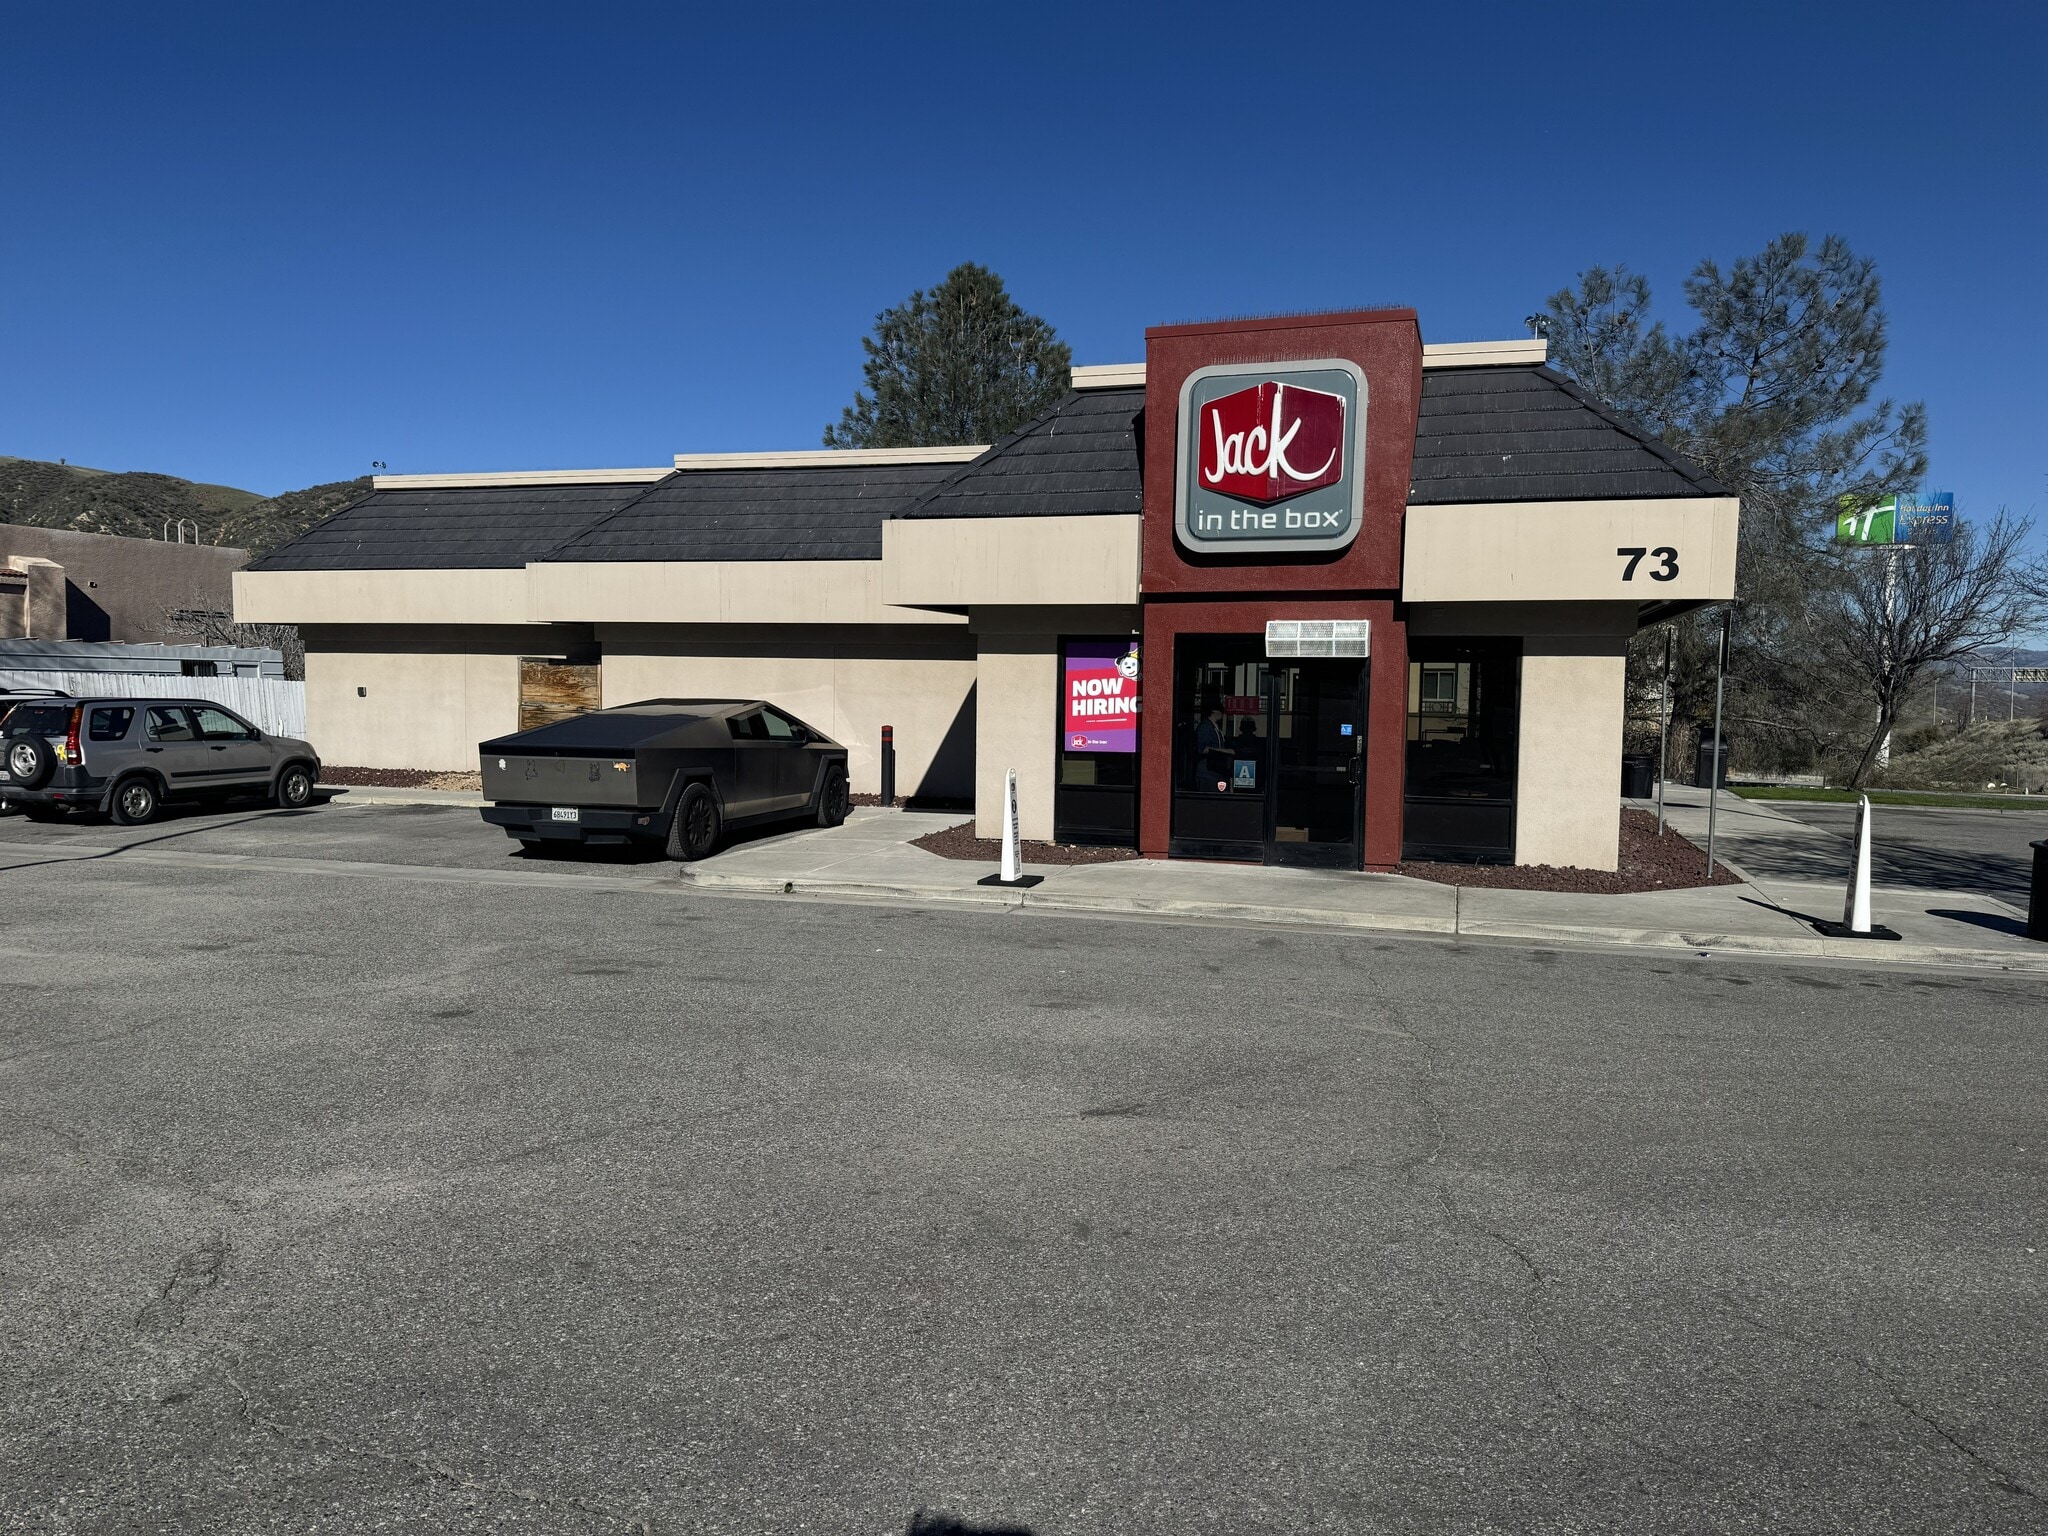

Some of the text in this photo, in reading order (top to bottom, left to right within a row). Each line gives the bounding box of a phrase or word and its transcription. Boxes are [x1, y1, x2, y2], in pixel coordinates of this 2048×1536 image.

[1204, 392, 1337, 484] Jack
[1935, 503, 1949, 512] Inn
[1198, 508, 1339, 530] in the box
[1899, 514, 1948, 526] Express
[1617, 546, 1680, 582] 73
[1072, 677, 1124, 697] NOW
[1072, 696, 1143, 716] HIRING
[1239, 765, 1251, 778] A
